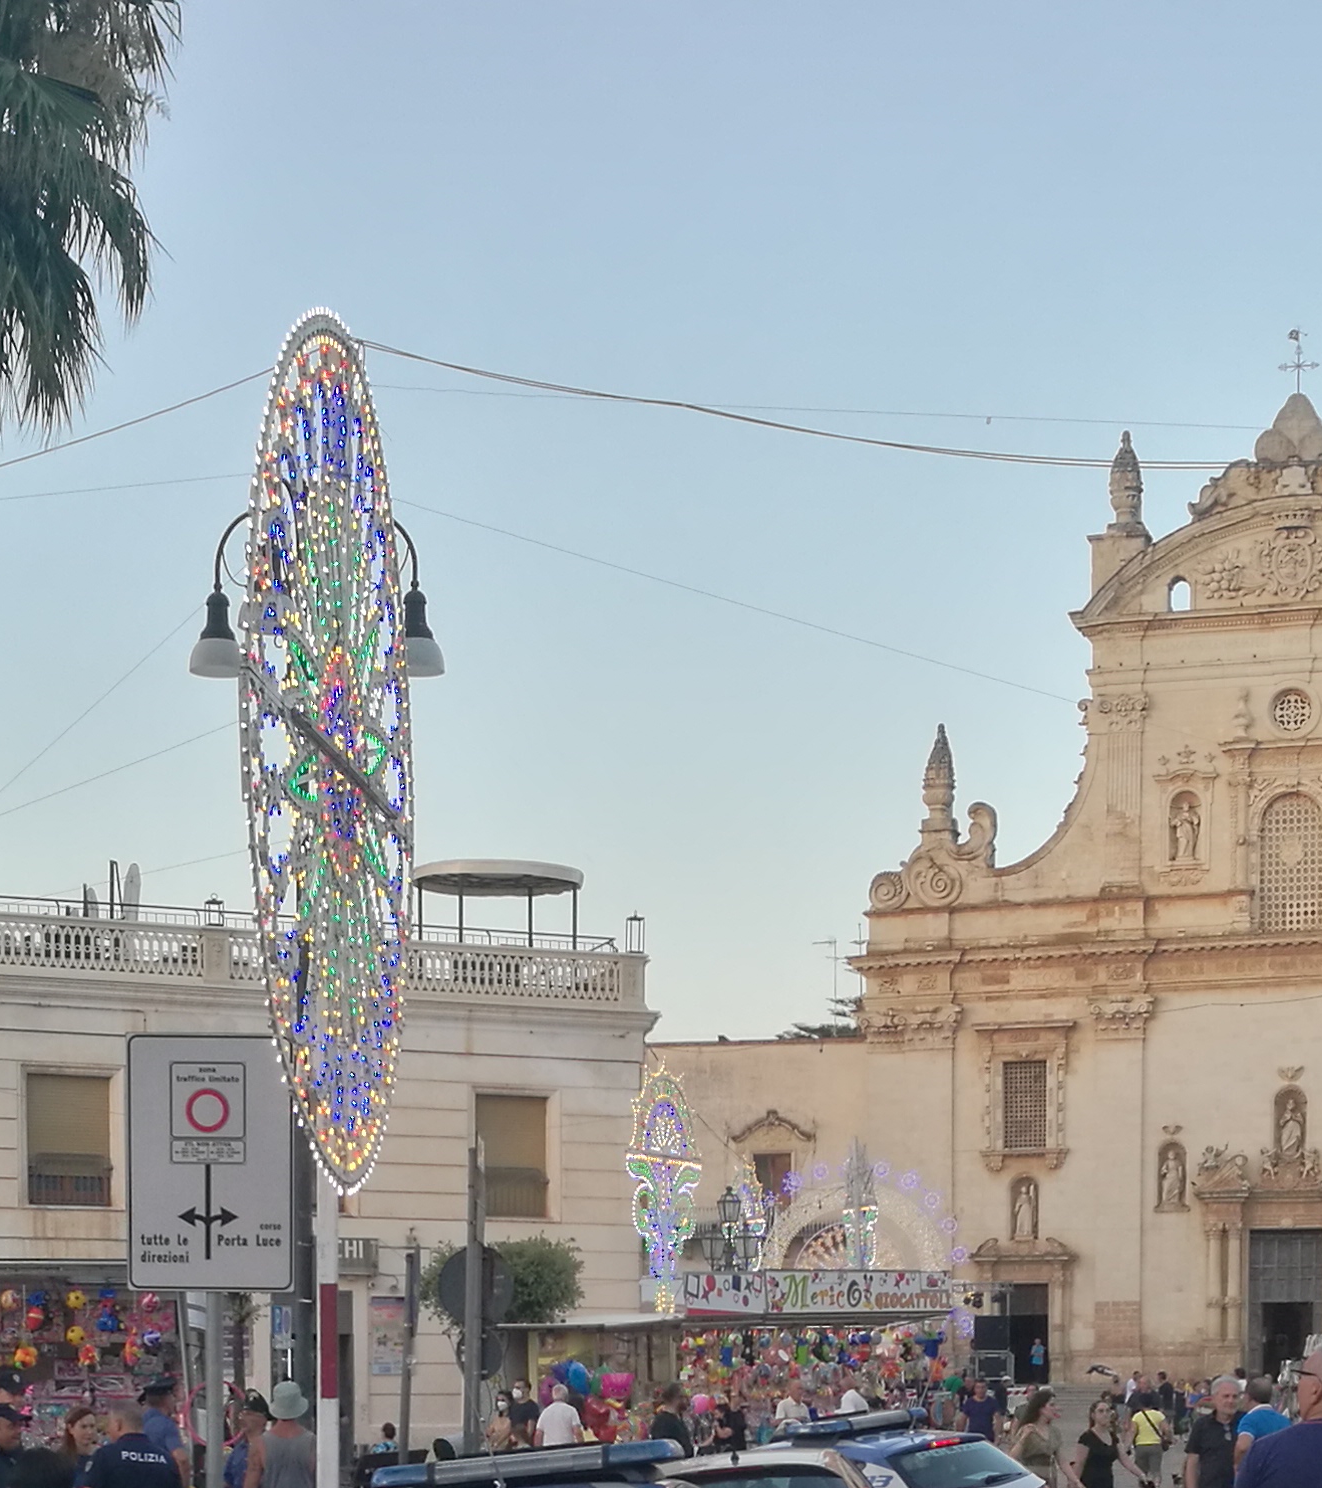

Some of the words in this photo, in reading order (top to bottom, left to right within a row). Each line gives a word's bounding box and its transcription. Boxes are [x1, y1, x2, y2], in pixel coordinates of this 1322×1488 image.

[176, 1075, 206, 1083] traffico
[208, 1075, 240, 1083] limitato
[140, 1234, 171, 1246] tutte
[177, 1234, 189, 1246] le
[217, 1234, 249, 1247] Porta
[256, 1234, 282, 1247] Luce
[140, 1251, 190, 1263] direzioni
[121, 1450, 168, 1464] POLIZIA
